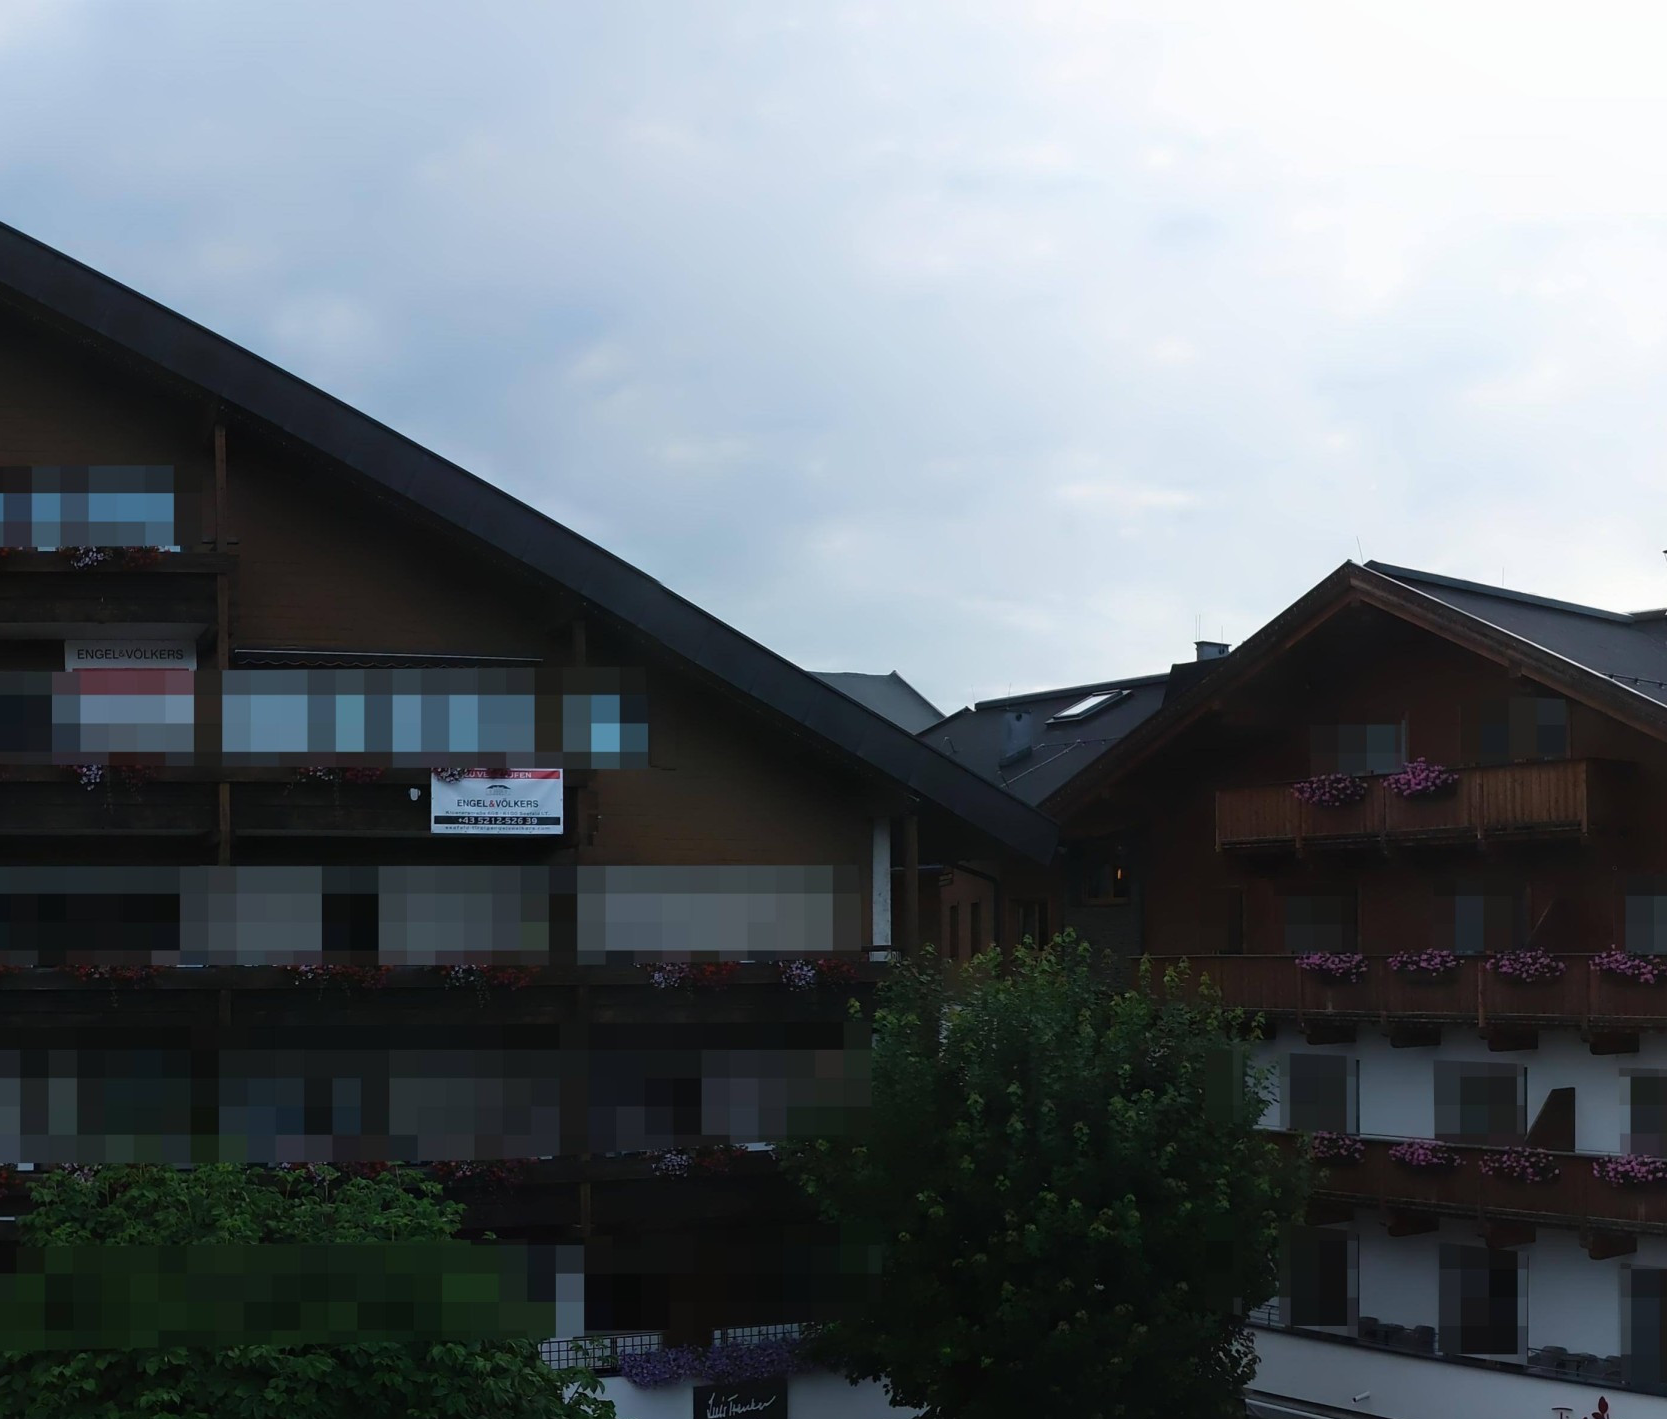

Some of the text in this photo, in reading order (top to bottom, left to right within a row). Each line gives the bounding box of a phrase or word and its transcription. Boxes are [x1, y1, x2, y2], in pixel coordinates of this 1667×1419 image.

[77, 648, 184, 660] ENGEL&VÖLKERS
[457, 798, 539, 808] ENGEL&VÖLKERS
[458, 816, 538, 825] +43 5212-526 39
